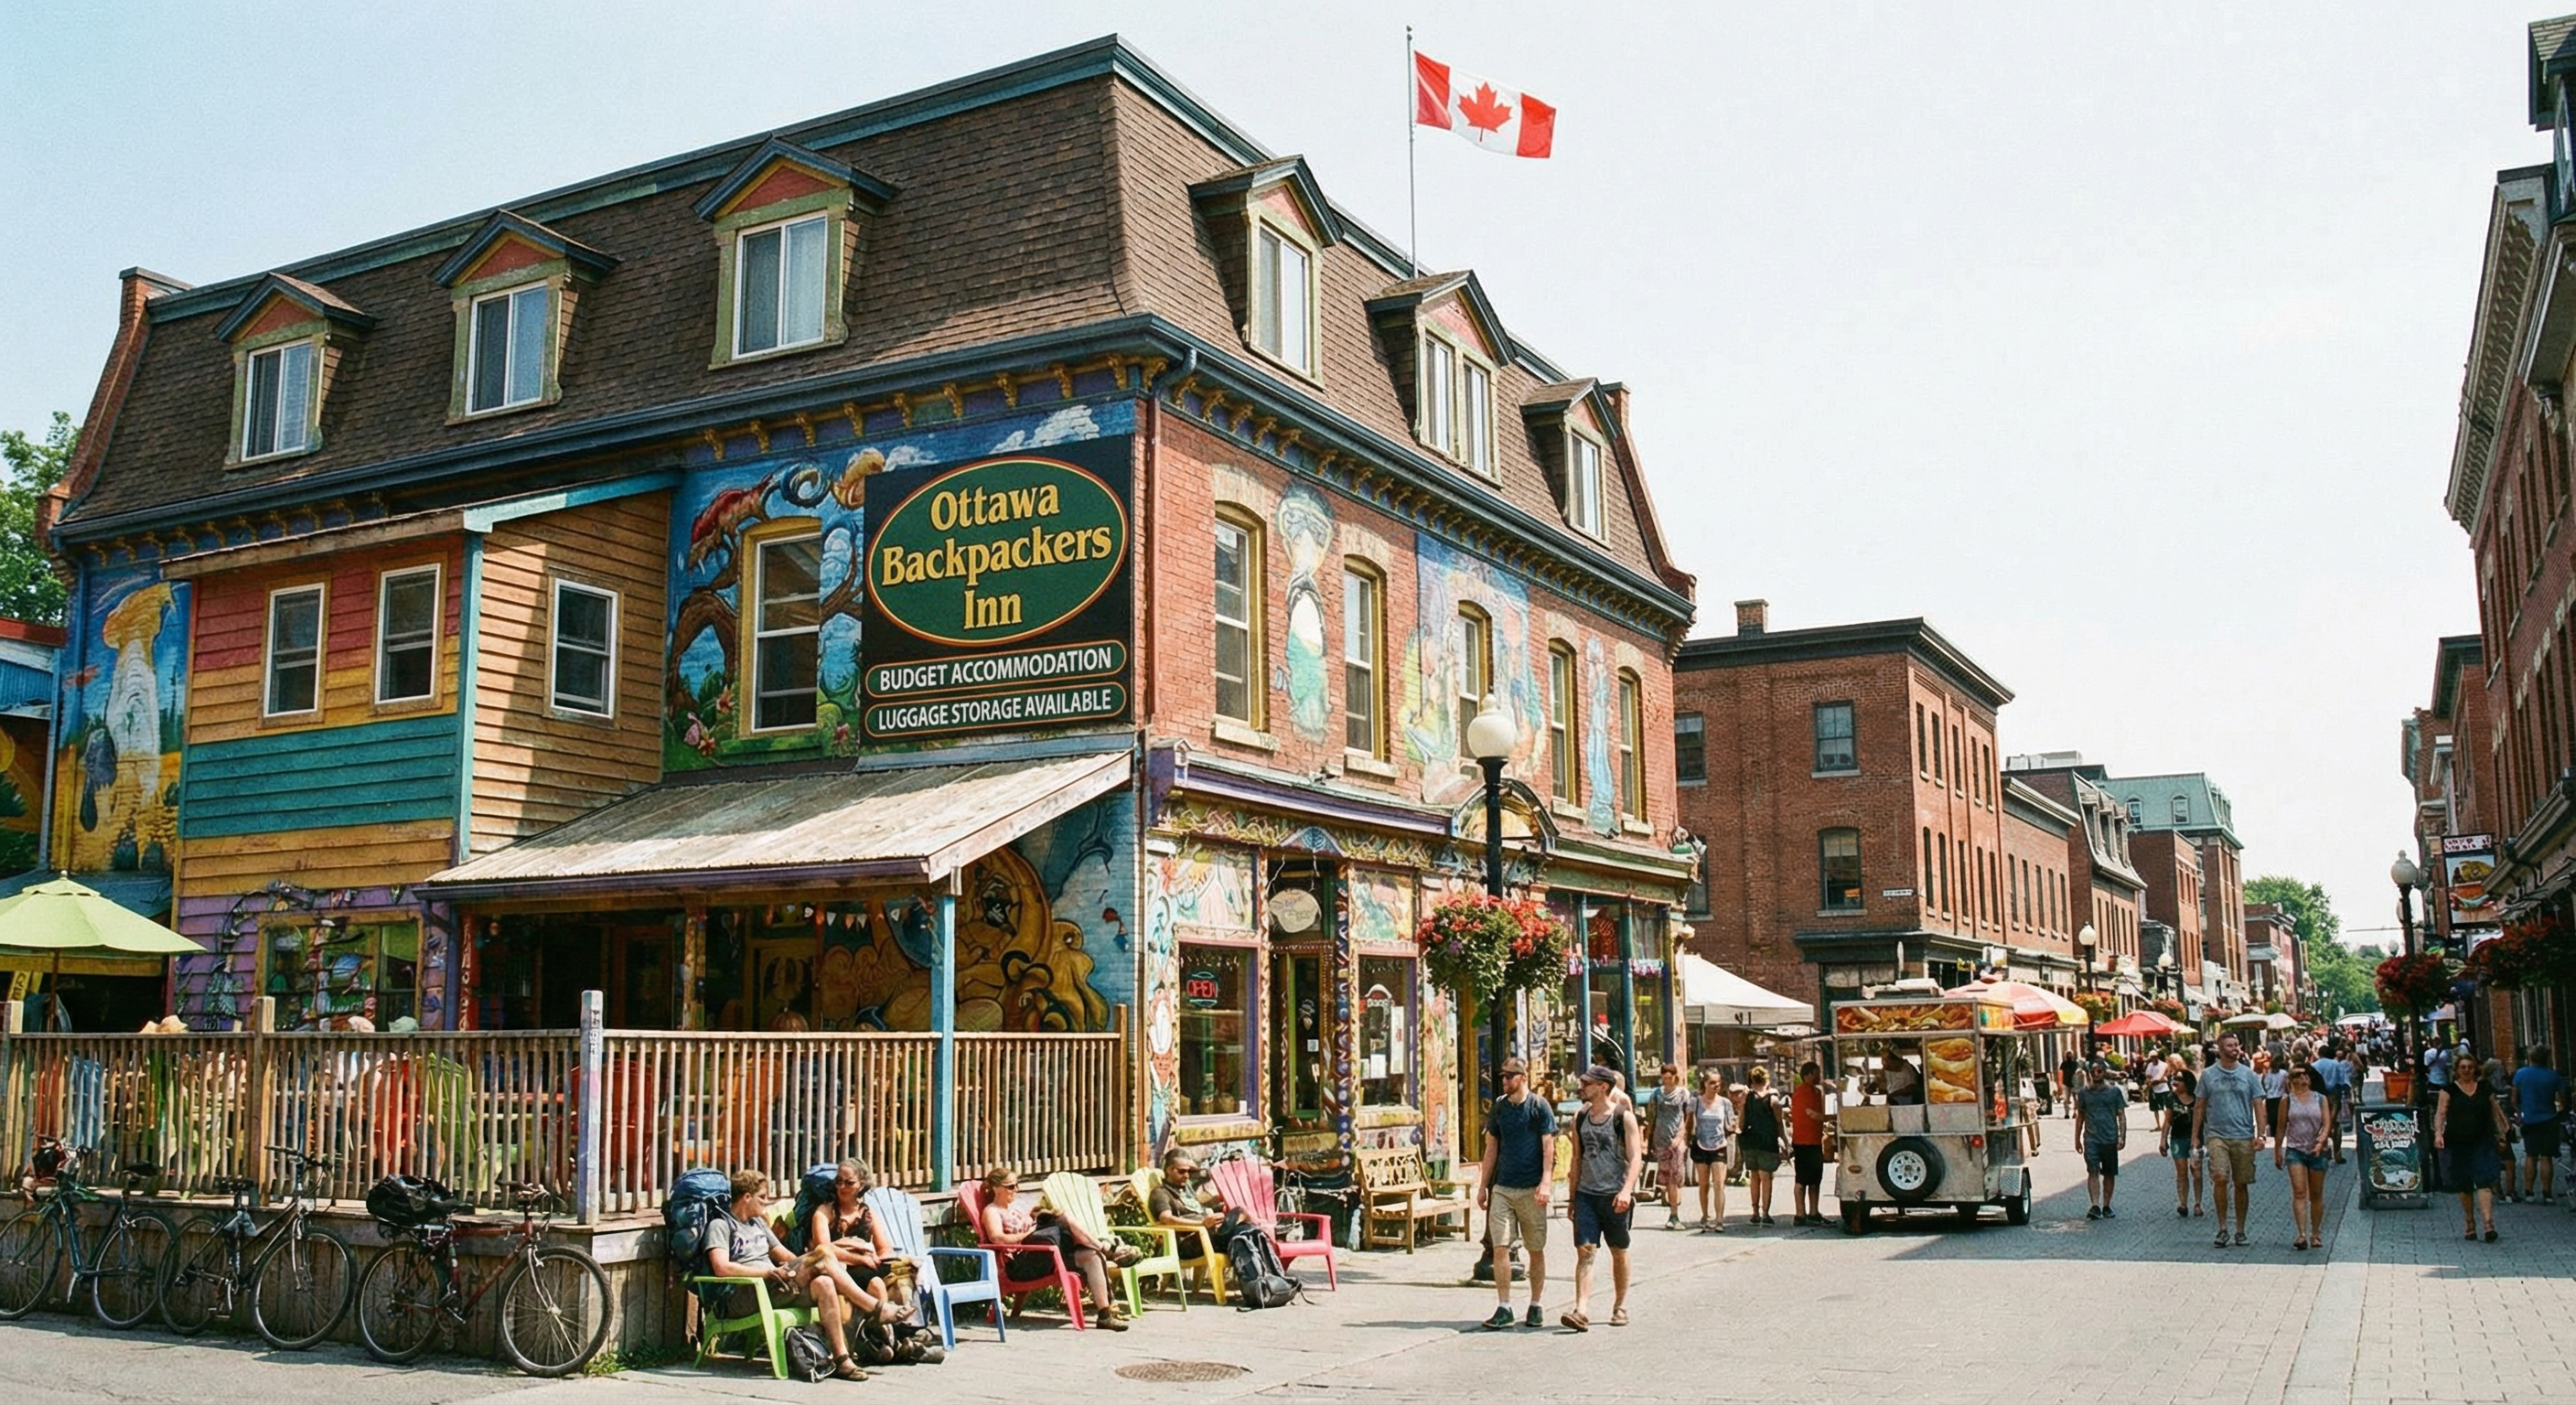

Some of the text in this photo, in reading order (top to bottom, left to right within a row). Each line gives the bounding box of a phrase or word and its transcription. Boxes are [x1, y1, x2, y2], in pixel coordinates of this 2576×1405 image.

[930, 483, 1059, 531] Ottawa
[881, 525, 1112, 586] Backpackers
[963, 590, 1022, 629] Inn
[880, 647, 1111, 691] BUDGET ACCOMMODATION
[878, 689, 1111, 730] LUGGAGE STORAGE AVAILABLE
[1187, 980, 1217, 999] OPEN
